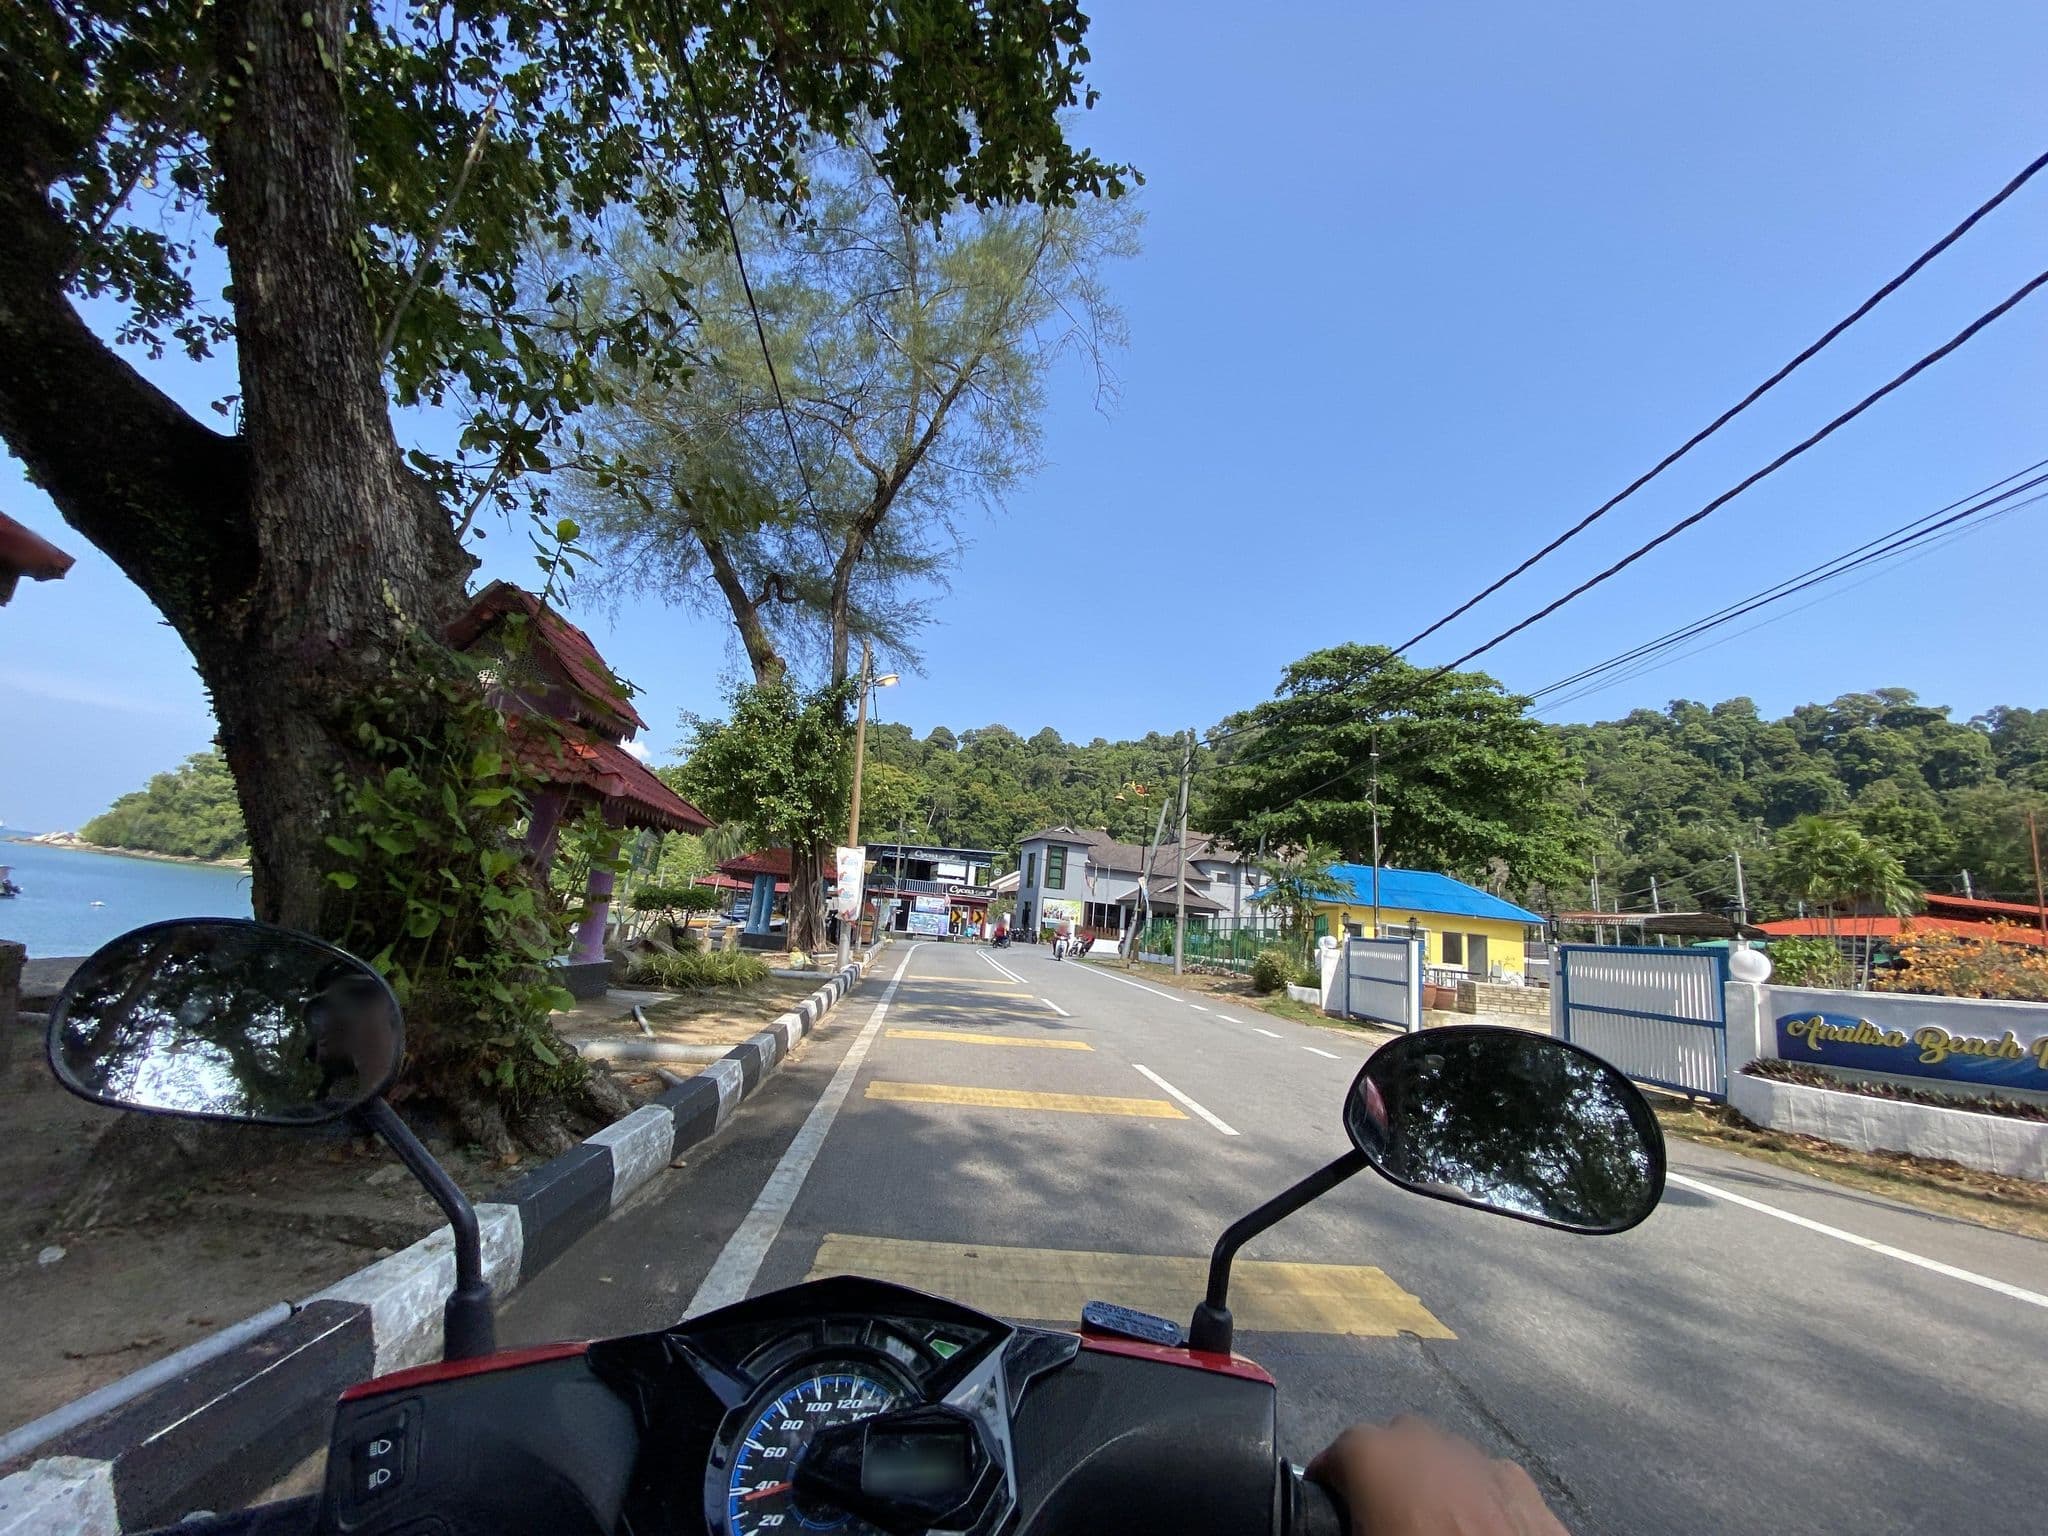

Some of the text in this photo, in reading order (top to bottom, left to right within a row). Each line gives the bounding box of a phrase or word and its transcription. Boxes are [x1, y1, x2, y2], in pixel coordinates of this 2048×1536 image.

[1787, 1015, 1907, 1050] Analisa
[1914, 1026, 2024, 1064] Beach
[805, 1402, 832, 1412] 100
[836, 1400, 863, 1409] 120
[780, 1420, 804, 1430] 80
[763, 1447, 788, 1458] 60
[758, 1514, 785, 1526] 20
